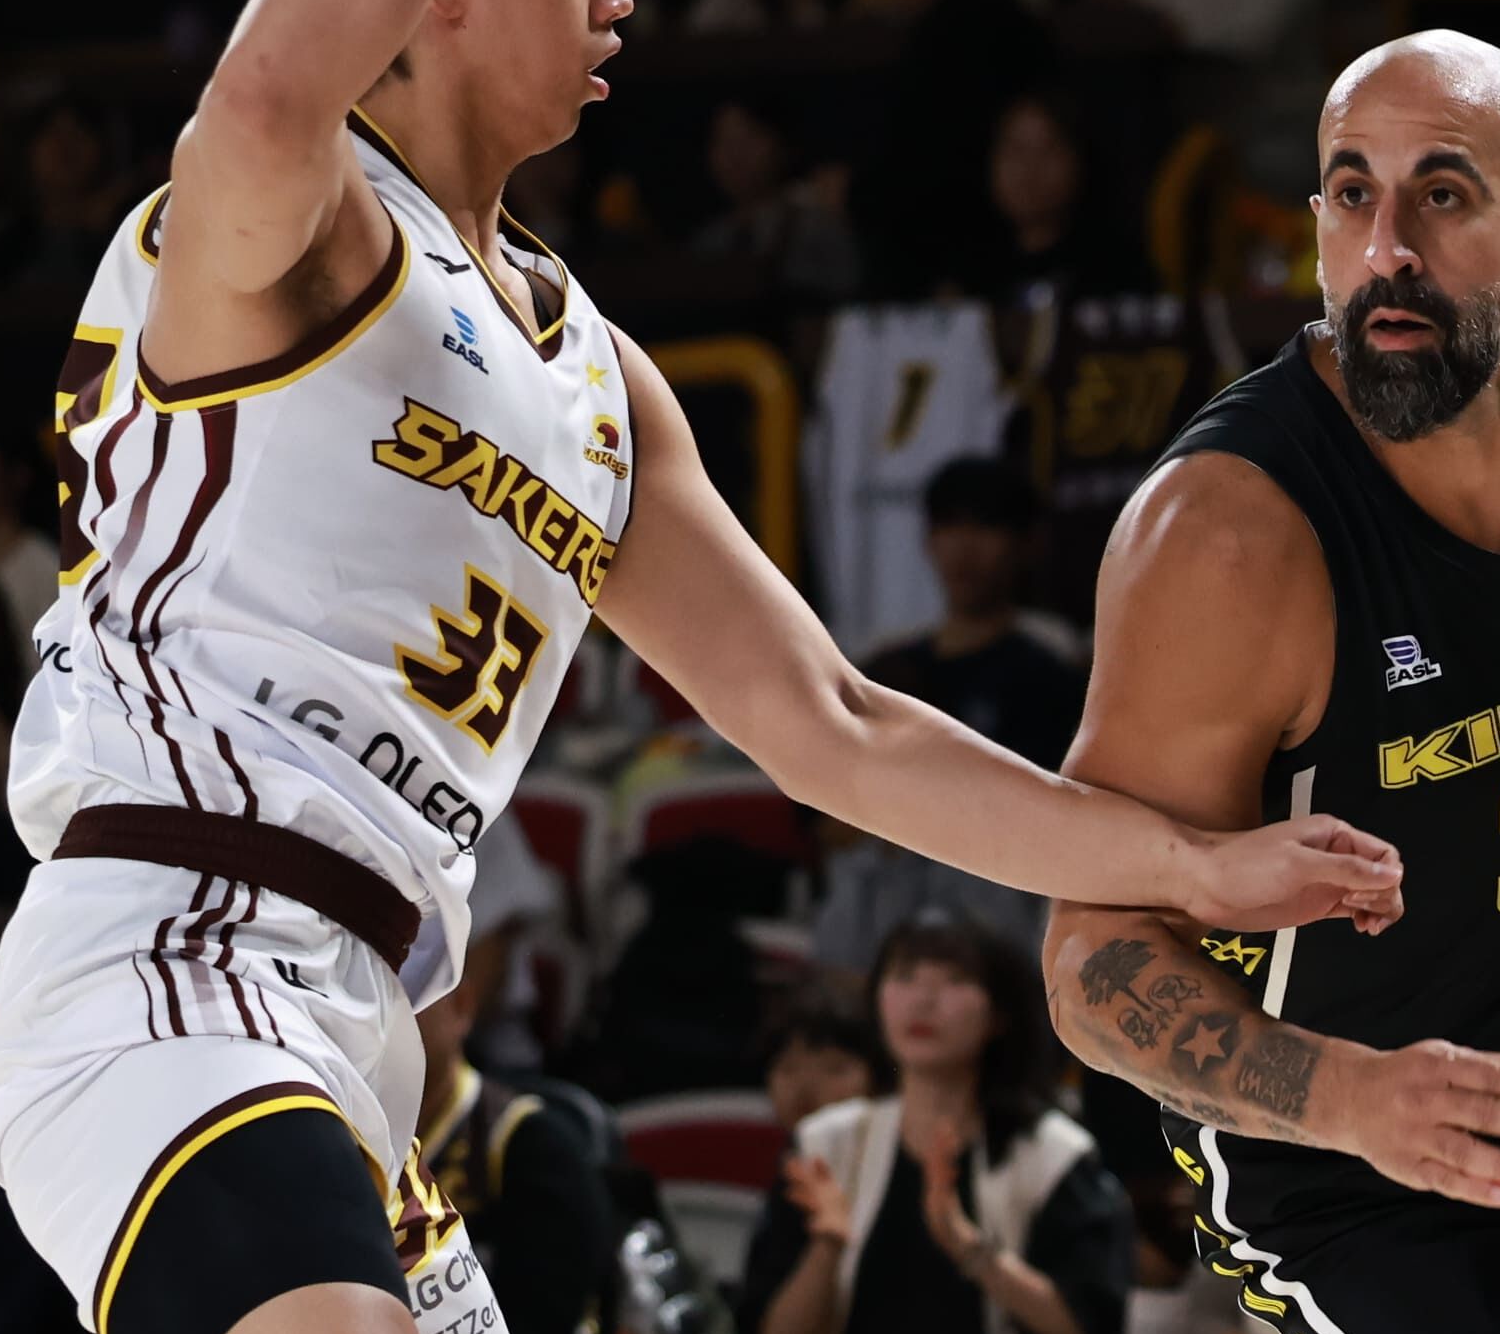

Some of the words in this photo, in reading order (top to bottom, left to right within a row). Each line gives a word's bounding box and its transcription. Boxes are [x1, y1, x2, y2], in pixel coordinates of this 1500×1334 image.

[442, 334, 489, 375] EASL
[372, 395, 616, 609] SAKERS
[393, 562, 551, 756] 33
[1387, 662, 1437, 686] EASL
